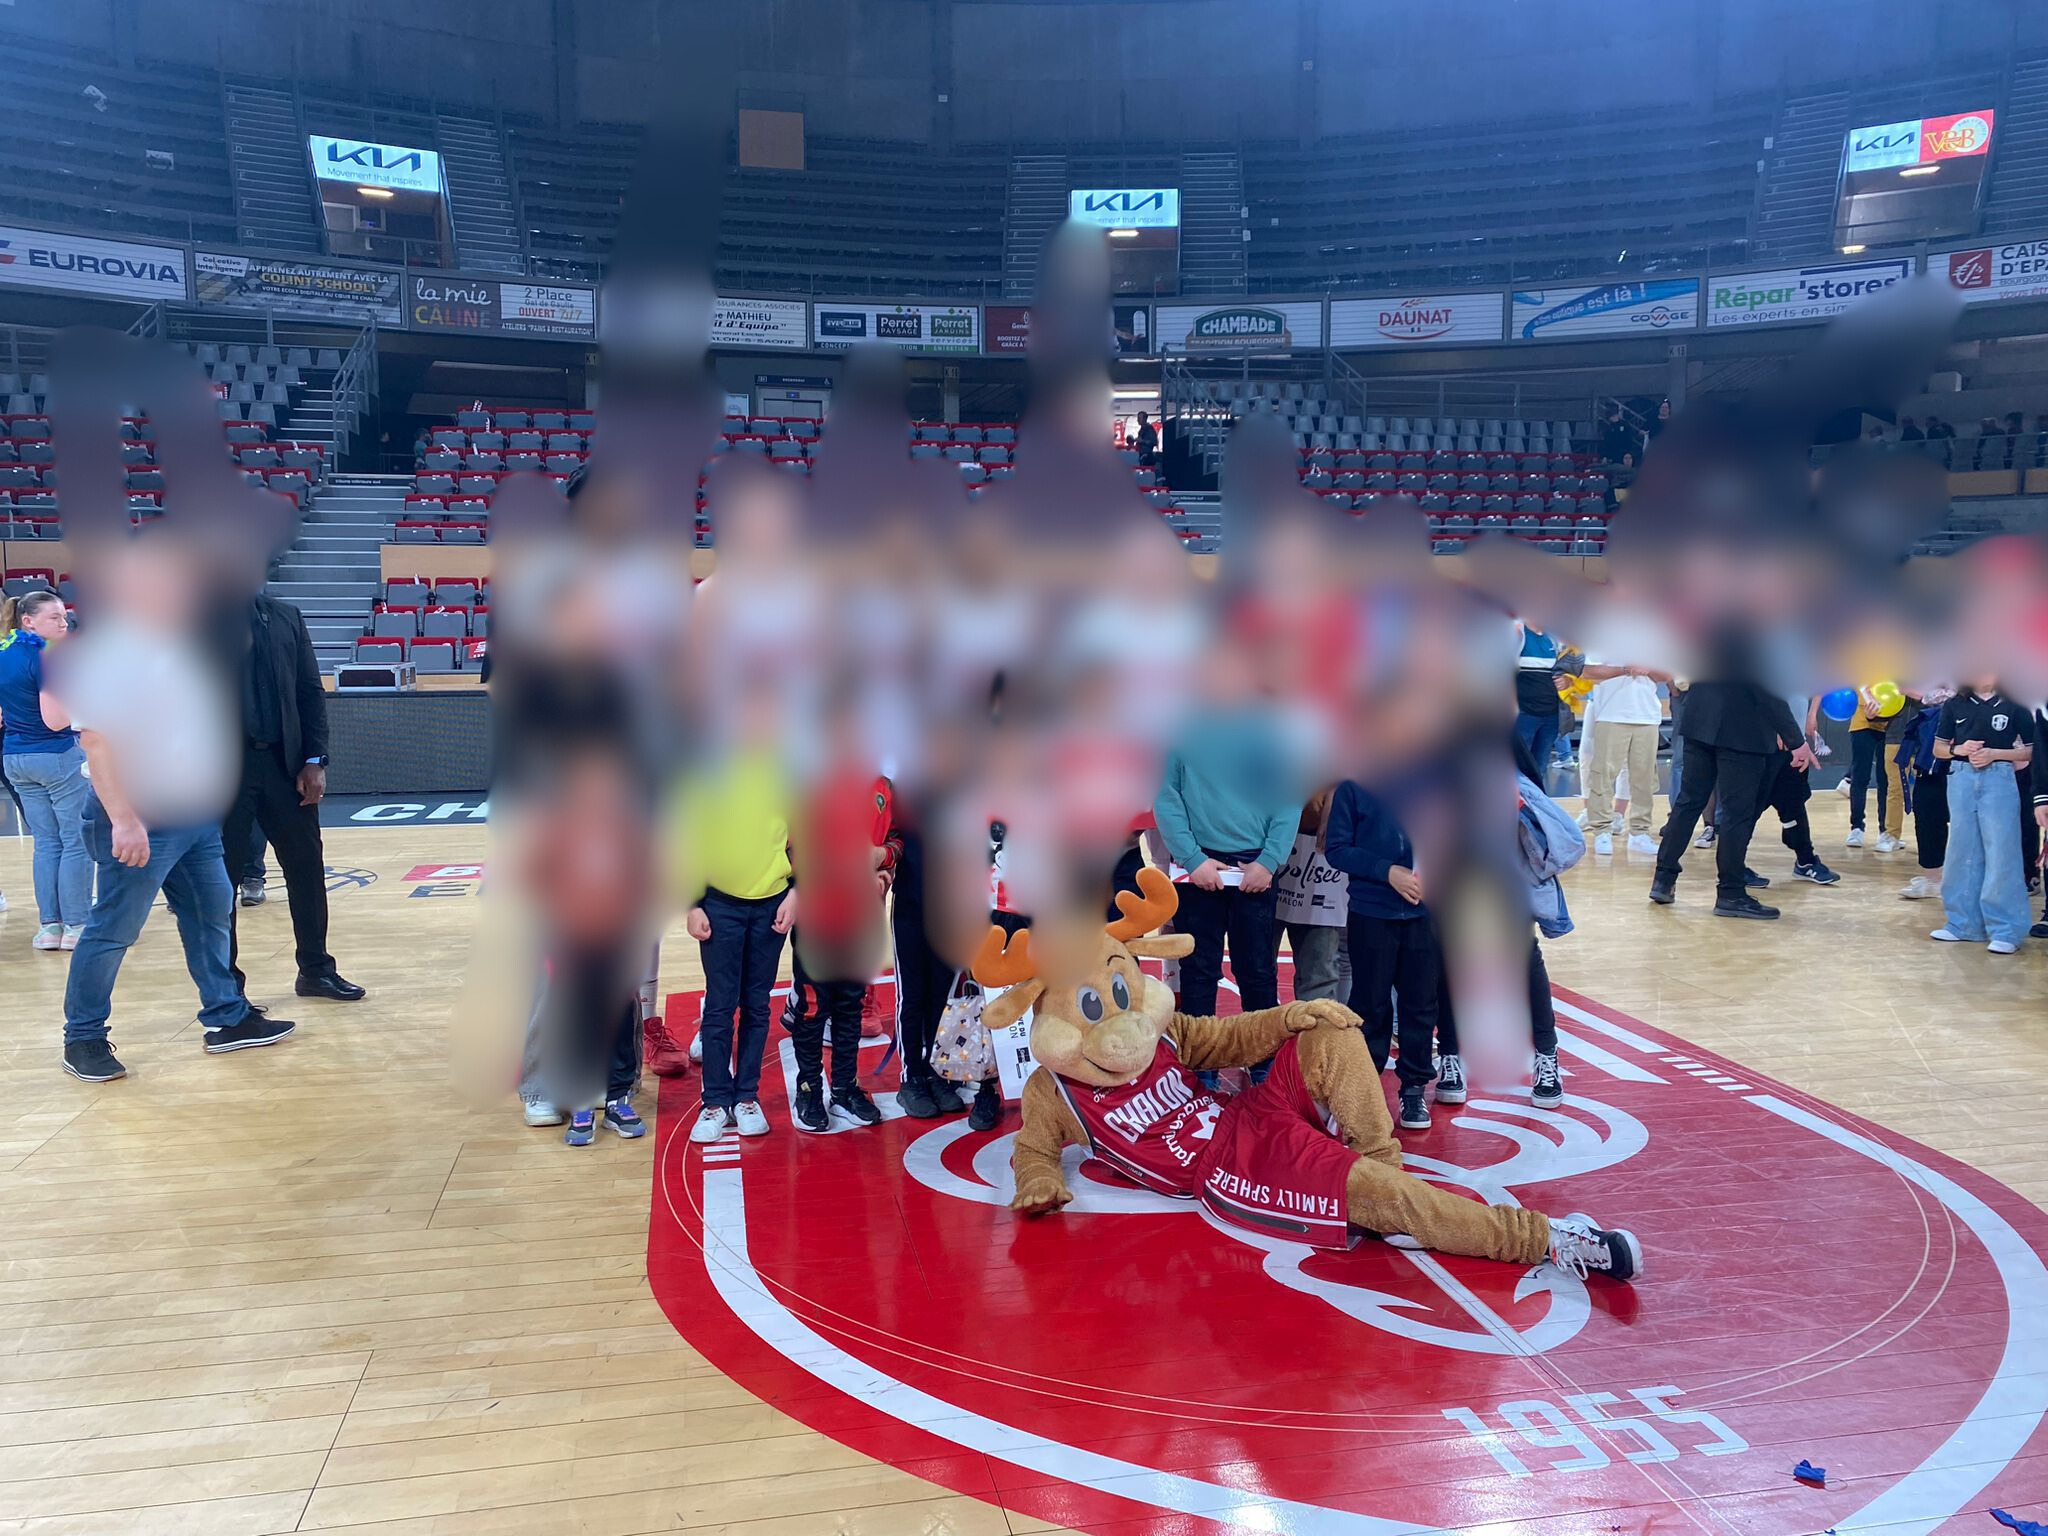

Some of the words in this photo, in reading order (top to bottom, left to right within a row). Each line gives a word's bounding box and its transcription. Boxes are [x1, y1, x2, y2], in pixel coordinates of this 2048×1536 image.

[1855, 131, 1915, 152] KIA
[327, 141, 421, 172] KIA
[327, 167, 372, 179] Movement
[374, 173, 390, 182] that
[392, 176, 423, 186] inspires
[1085, 192, 1163, 212] KIA
[2001, 242, 2048, 260] CAIS
[28, 249, 180, 283] EUROVIA
[250, 264, 297, 275] APPRENEZ
[299, 267, 352, 280] AUTREMENT
[354, 274, 376, 282] AVEC
[377, 275, 389, 283] LA
[261, 272, 311, 286] COLINT
[317, 278, 377, 293] SCHOOL!
[416, 277, 443, 302] la
[445, 283, 492, 306] mie
[524, 287, 532, 298] 2
[537, 288, 572, 301] Place
[1587, 294, 1610, 308] est
[1614, 286, 1632, 303] là
[519, 307, 555, 318] OUVERT
[717, 300, 762, 309] SSURANCES
[415, 302, 490, 328] CÂLINE
[726, 311, 772, 321] MATHIEU
[880, 318, 918, 328] Perret
[934, 318, 969, 328] Perret
[1379, 308, 1452, 327] DAUNAT
[1630, 311, 1689, 322] COVAGE
[1714, 313, 1738, 324] Les
[1742, 308, 1796, 326] experts
[1802, 307, 1820, 316] en
[502, 322, 526, 331] ATELIERS
[880, 327, 918, 335] PAYSAGE
[1202, 316, 1276, 334] CHAMBADE
[1234, 337, 1285, 345] BOURGOGNE
[1103, 1067, 1194, 1143] CHALON
[1211, 1166, 1271, 1202] SPHERE
[1275, 1188, 1339, 1217] FAMILY
[1441, 1384, 1750, 1479] 1955
